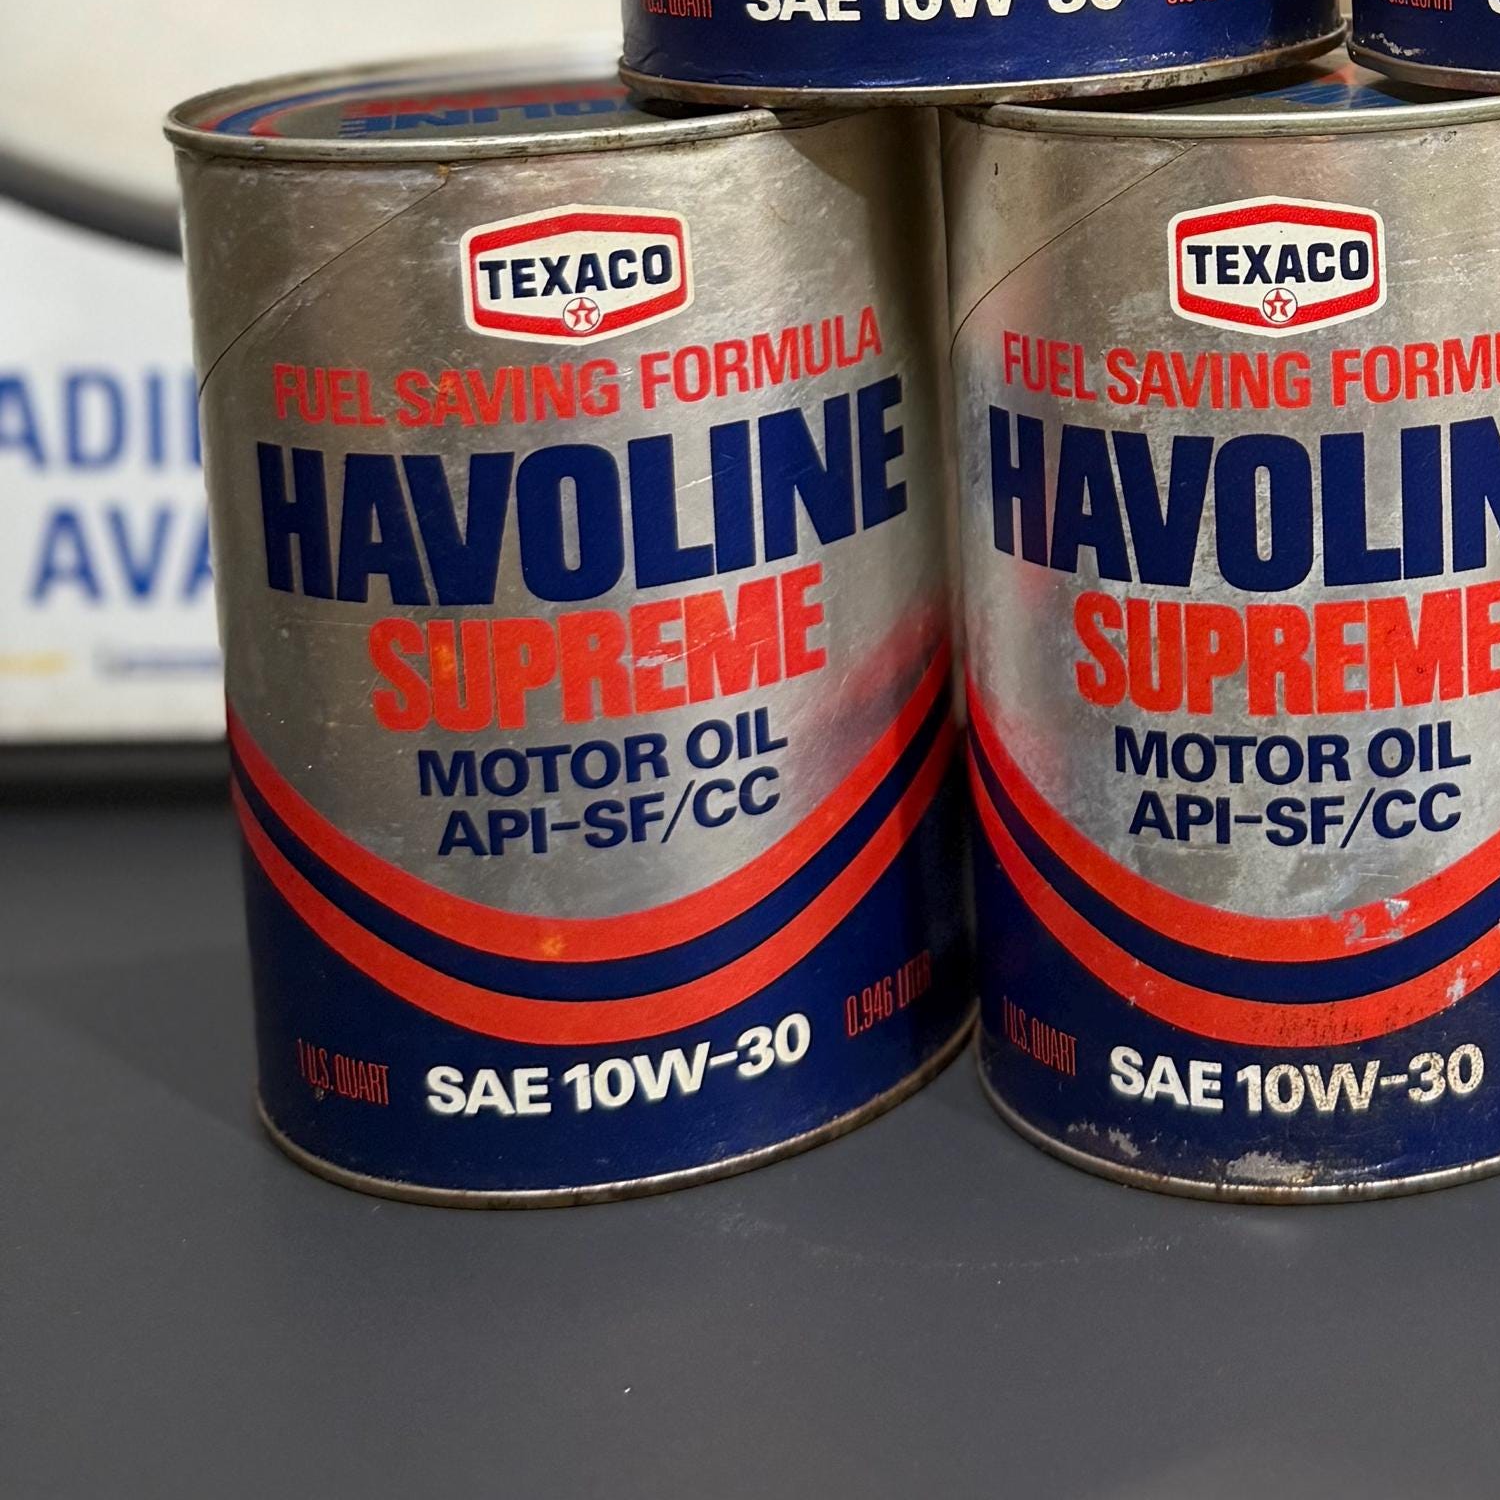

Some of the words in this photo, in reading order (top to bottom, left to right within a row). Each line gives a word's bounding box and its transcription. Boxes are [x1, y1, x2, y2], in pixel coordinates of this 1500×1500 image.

[340, 99, 634, 139] OLINE
[479, 244, 672, 301] TEXACO
[1187, 240, 1369, 285] TEXACO
[273, 362, 385, 427] FUEL
[394, 357, 618, 428] SAVING
[640, 305, 882, 408] FORMULA
[1003, 329, 1095, 400] FUEL
[1106, 347, 1311, 410] SAVING
[0, 366, 202, 471] ADI
[256, 374, 908, 606] HAVOLINE
[368, 564, 826, 733] SUPREME
[417, 730, 668, 797] MOTOR
[685, 706, 788, 771] OIL
[1115, 726, 1351, 785] MOTOR
[1368, 722, 1471, 774] OIL
[437, 765, 782, 857] API-SF/CC
[1129, 783, 1461, 849] API-SF/CC
[846, 975, 893, 1037] 0.946
[1009, 1001, 1030, 1053] U.S.
[1032, 1018, 1077, 1076] QUART
[307, 1042, 334, 1091] U.S.
[335, 1054, 389, 1105] QUART
[426, 1064, 550, 1117] SAE
[564, 1013, 811, 1111] 10W-30
[1110, 1045, 1223, 1109] SAE
[1236, 1043, 1485, 1113] 10W-30
